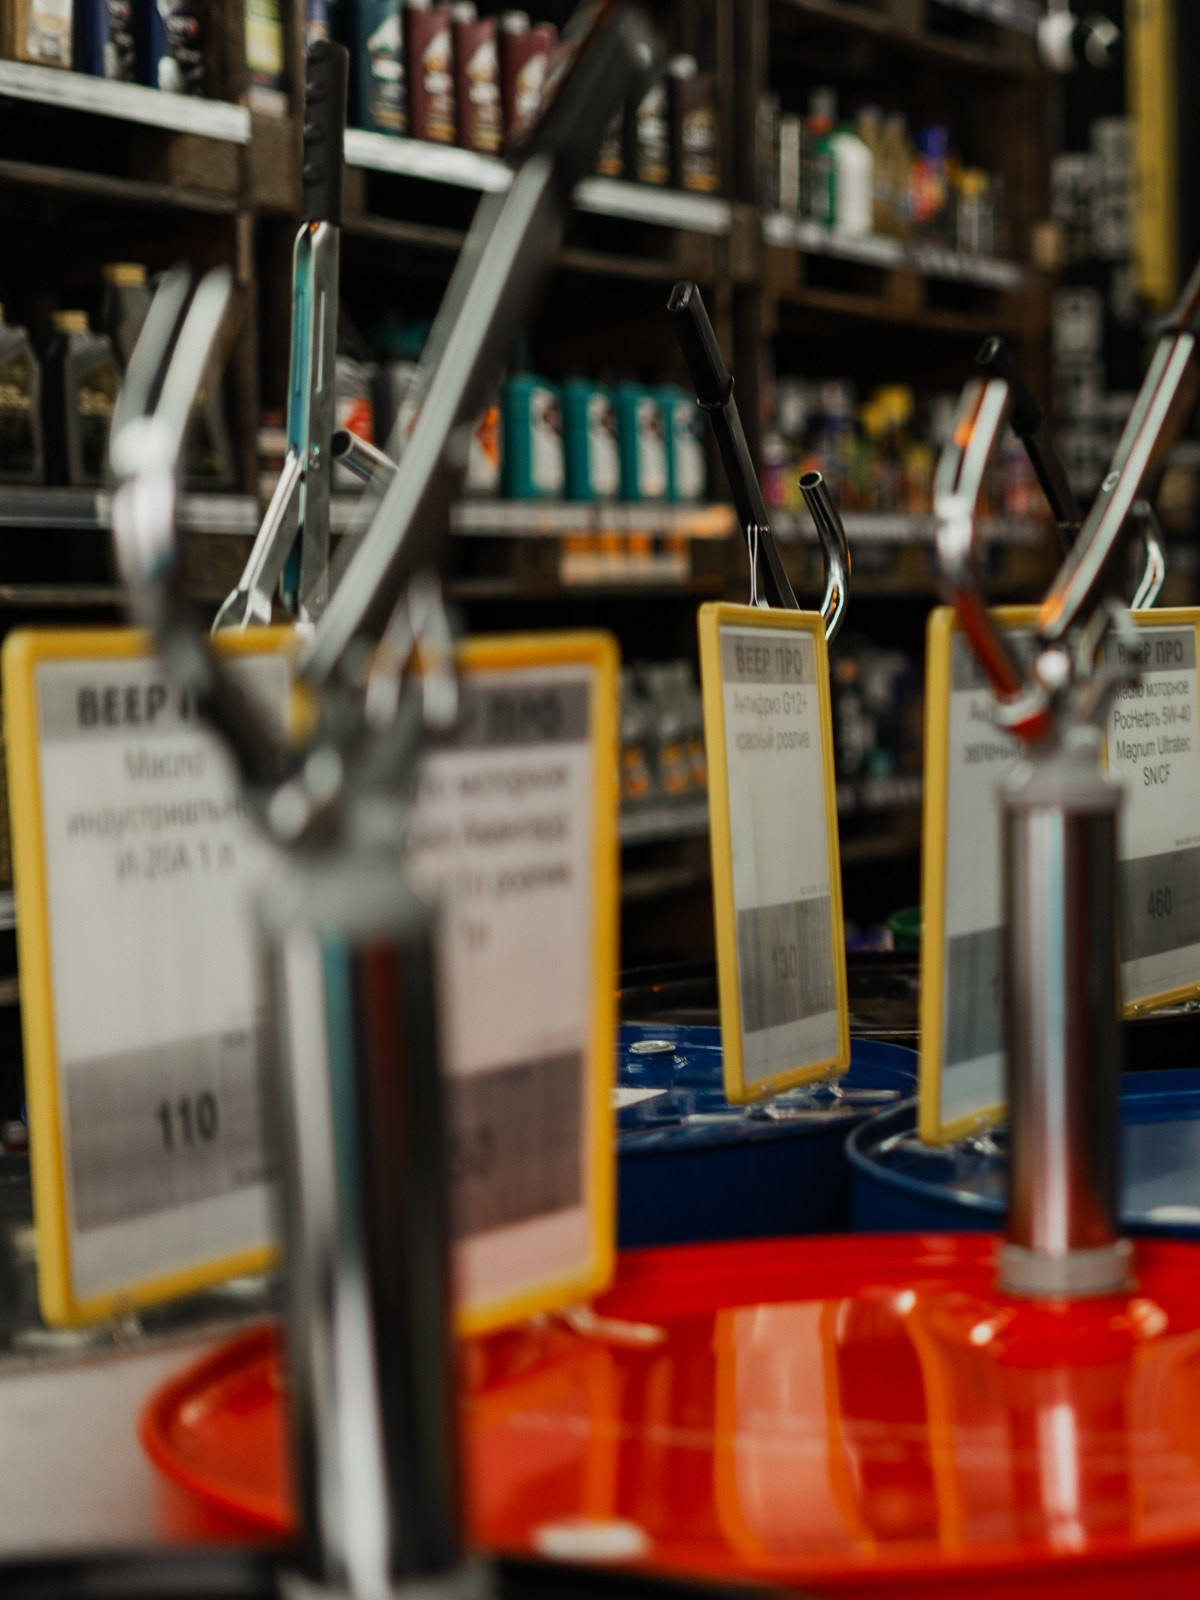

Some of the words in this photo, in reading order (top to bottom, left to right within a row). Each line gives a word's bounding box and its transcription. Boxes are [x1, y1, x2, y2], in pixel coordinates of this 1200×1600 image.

[735, 645, 771, 674] ВЕЕР
[774, 647, 804, 676] ПРО
[1156, 639, 1184, 664] ПРО
[1146, 679, 1190, 699] моторное
[77, 685, 168, 729] ВЕЕР
[1114, 706, 1161, 731] РосНефть
[1162, 704, 1191, 727] 5W-40
[1116, 740, 1156, 763] Magnum
[1147, 886, 1173, 918] 460
[156, 1089, 220, 1151] 110
